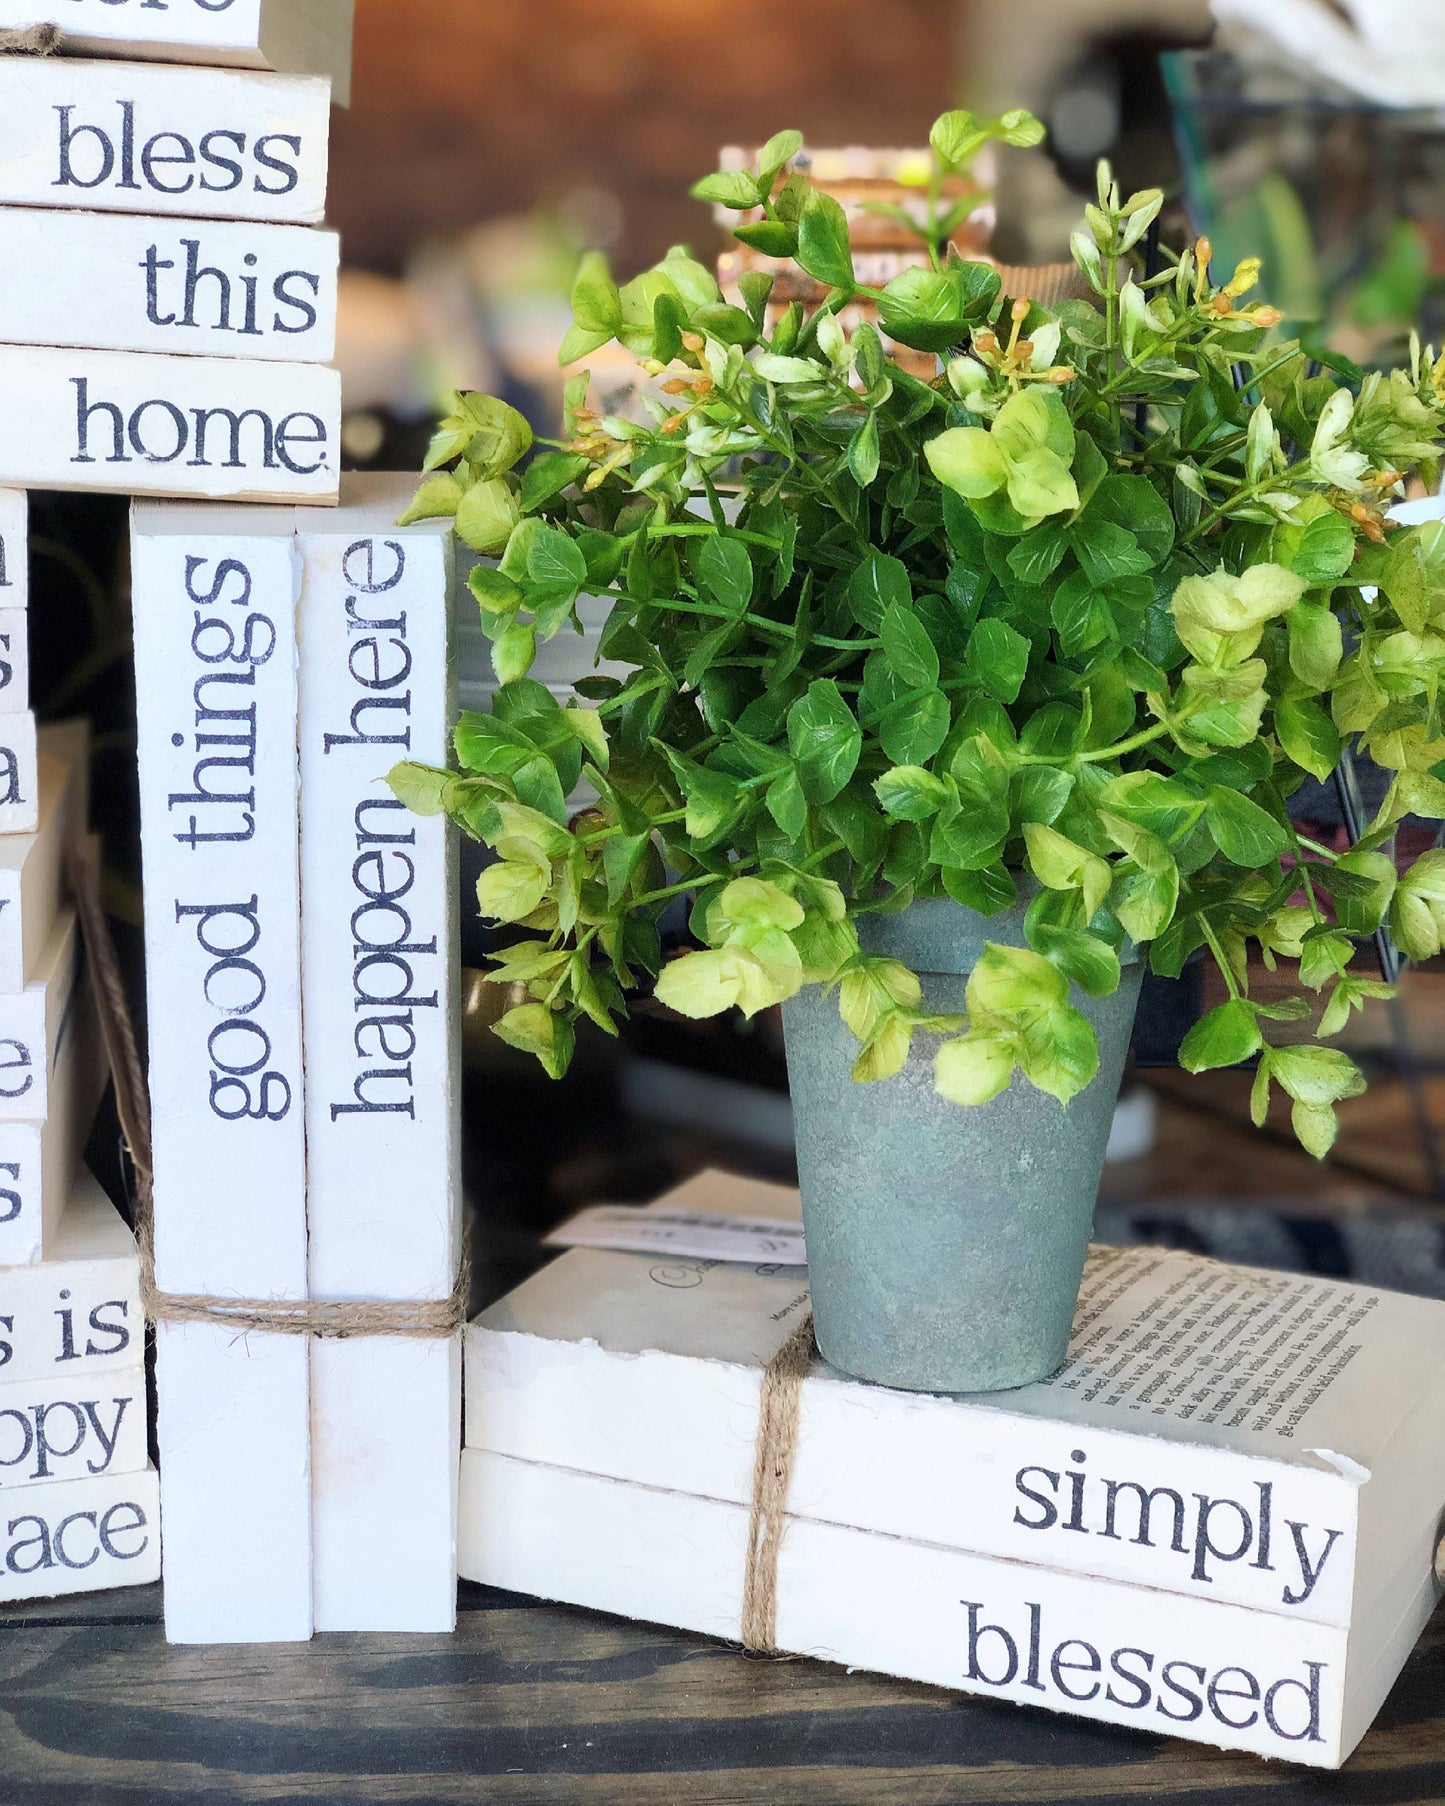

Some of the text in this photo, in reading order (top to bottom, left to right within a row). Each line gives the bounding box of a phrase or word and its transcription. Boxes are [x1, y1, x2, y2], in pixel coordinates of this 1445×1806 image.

[51, 99, 302, 195] bless
[138, 238, 320, 336] this
[68, 377, 328, 475] home
[168, 553, 291, 1121] good things
[322, 536, 438, 1122] happen here
[54, 1288, 131, 1362] is
[1303, 1331, 1318, 1341] was
[1060, 1379, 1081, 1389] He
[1076, 1366, 1094, 1377] was
[1085, 1355, 1110, 1365] big
[1102, 1342, 1119, 1354] and
[1114, 1328, 1134, 1341] wore
[1069, 1346, 1092, 1359] only
[1083, 1326, 1111, 1347] prudent.
[1290, 1342, 1309, 1351] He
[1080, 1377, 1110, 1401] and-red
[1101, 1353, 1135, 1377] diamond
[1125, 1331, 1160, 1353] leggings
[1152, 1319, 1169, 1331] and
[1100, 1394, 1121, 1406] hat
[1114, 1380, 1135, 1394] with
[1145, 1344, 1175, 1361] floppy
[1181, 1318, 1197, 1329] and
[1197, 1412, 1218, 1423] his
[1211, 1390, 1237, 1411] crouch
[1230, 1377, 1250, 1389] with
[1262, 1330, 1293, 1356] movement
[1264, 1367, 1284, 1378] her
[1326, 1368, 1341, 1376] no
[1136, 1370, 1176, 1403] grotesquely
[1174, 1403, 1197, 1419] dark
[1190, 1386, 1215, 1402] alley
[1206, 1374, 1224, 1385] was
[1238, 1336, 1260, 1346] The
[1251, 1415, 1272, 1431] wild
[1264, 1402, 1282, 1416] and
[1274, 1381, 1301, 1403] without
[1296, 1363, 1317, 1377] trace
[1308, 1355, 1323, 1364] of
[1262, 1378, 1276, 1386] in
[1312, 1374, 1334, 1387] held
[1151, 1406, 1166, 1414] to
[1159, 1397, 1175, 1406] be
[1245, 1385, 1269, 1405] caught
[1288, 1404, 1309, 1415] his
[1302, 1387, 1324, 1405] attack
[1222, 1407, 1249, 1426] breath
[1275, 1425, 1294, 1437] gle
[1286, 1413, 1302, 1425] cat
[1013, 1449, 1344, 1604] simply
[960, 1600, 1329, 1744] blessed
